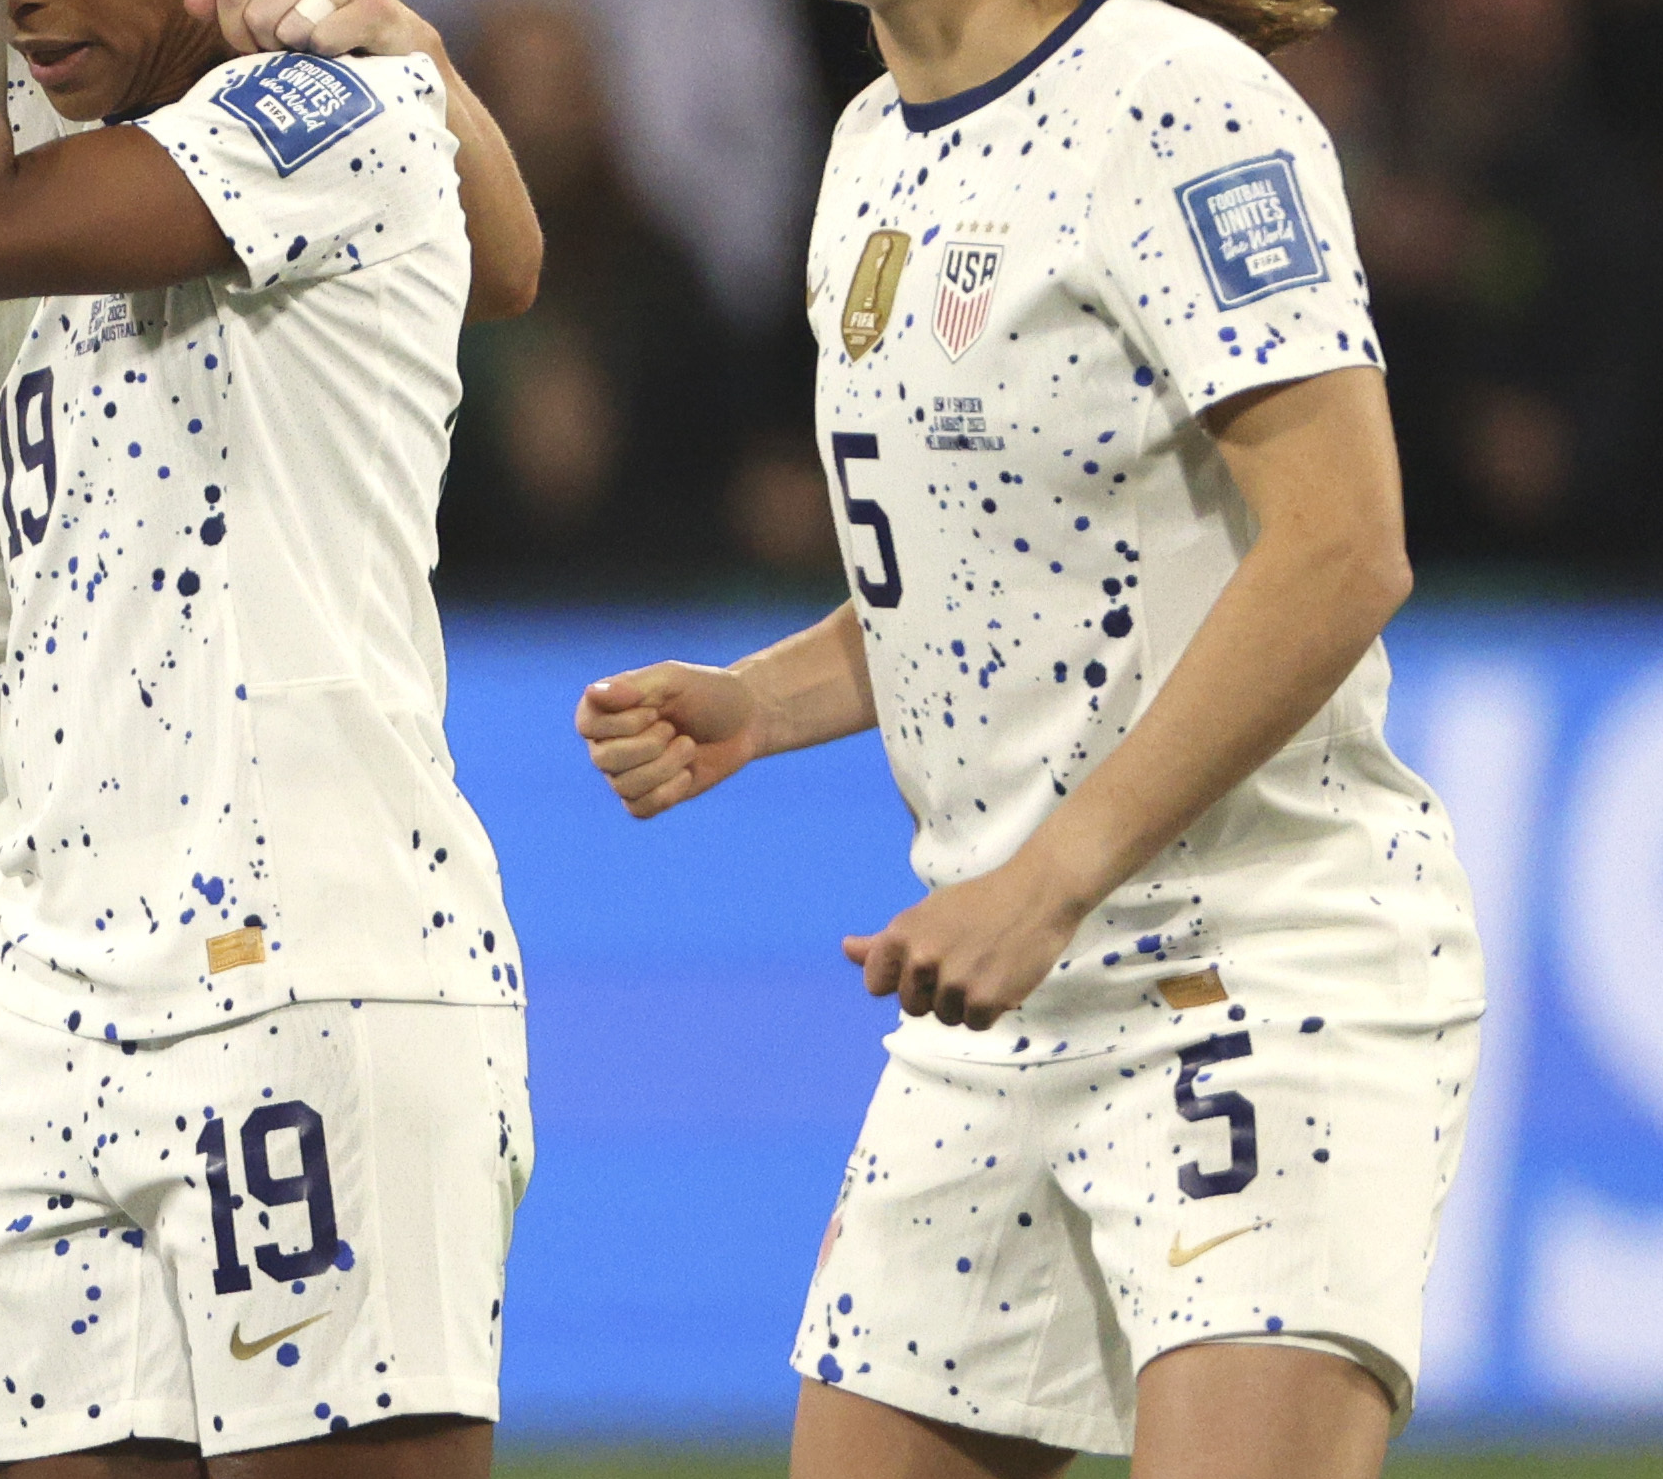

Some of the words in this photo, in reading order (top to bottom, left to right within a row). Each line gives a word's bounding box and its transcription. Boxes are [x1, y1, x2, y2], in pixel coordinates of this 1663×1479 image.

[259, 77, 285, 94] the
[280, 88, 327, 133] World
[277, 67, 340, 117] UNITES
[293, 60, 352, 106] FOOTBALL
[263, 101, 288, 125] FIFA
[1207, 179, 1277, 214] FOOTBALL
[1213, 196, 1286, 238] UNITES
[946, 249, 998, 294] USA
[1252, 253, 1282, 269] FIFA
[850, 311, 876, 329] FIFA
[831, 432, 903, 610] 5
[1174, 1030, 1258, 1200] 5
[196, 1099, 338, 1296] 19
